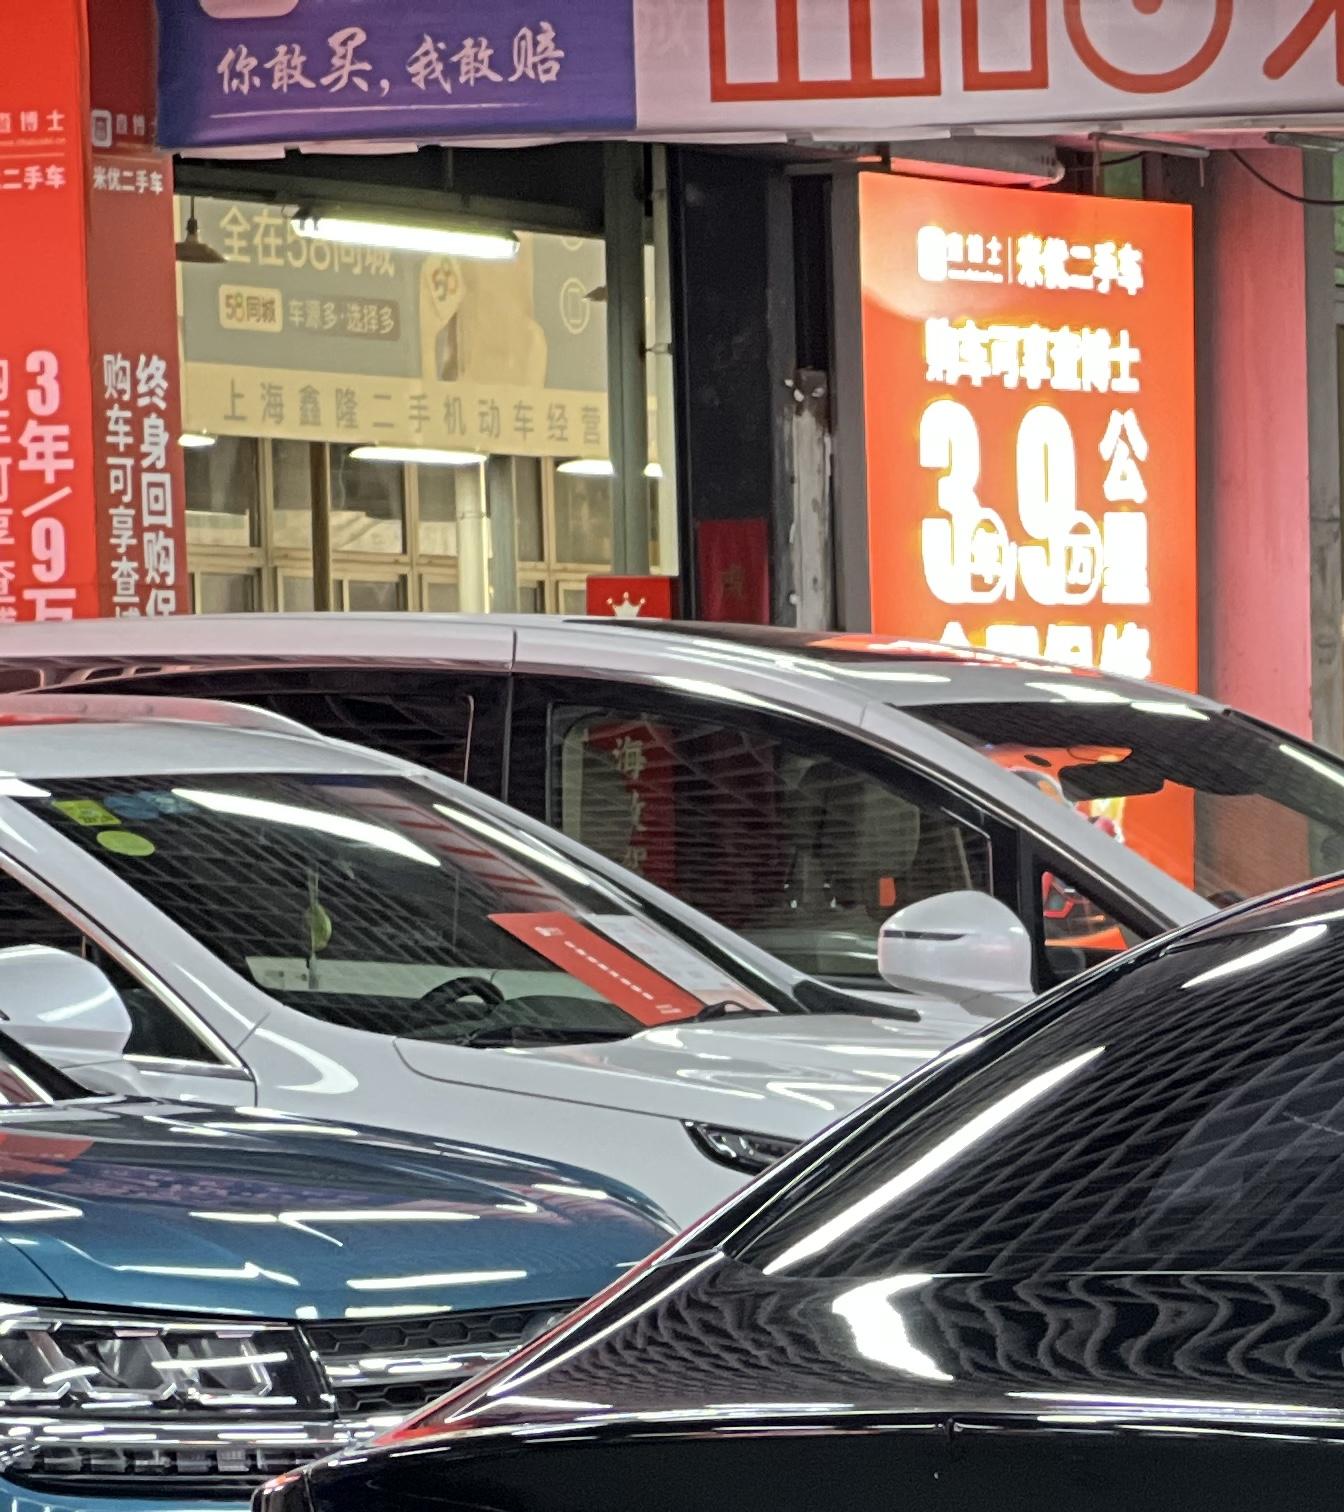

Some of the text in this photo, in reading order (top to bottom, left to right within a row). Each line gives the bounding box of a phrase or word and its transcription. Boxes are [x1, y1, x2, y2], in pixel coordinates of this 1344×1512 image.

[0, 165, 65, 189] 二手车
[92, 166, 164, 195] 米优二手车
[103, 353, 141, 617] 购车可享查
